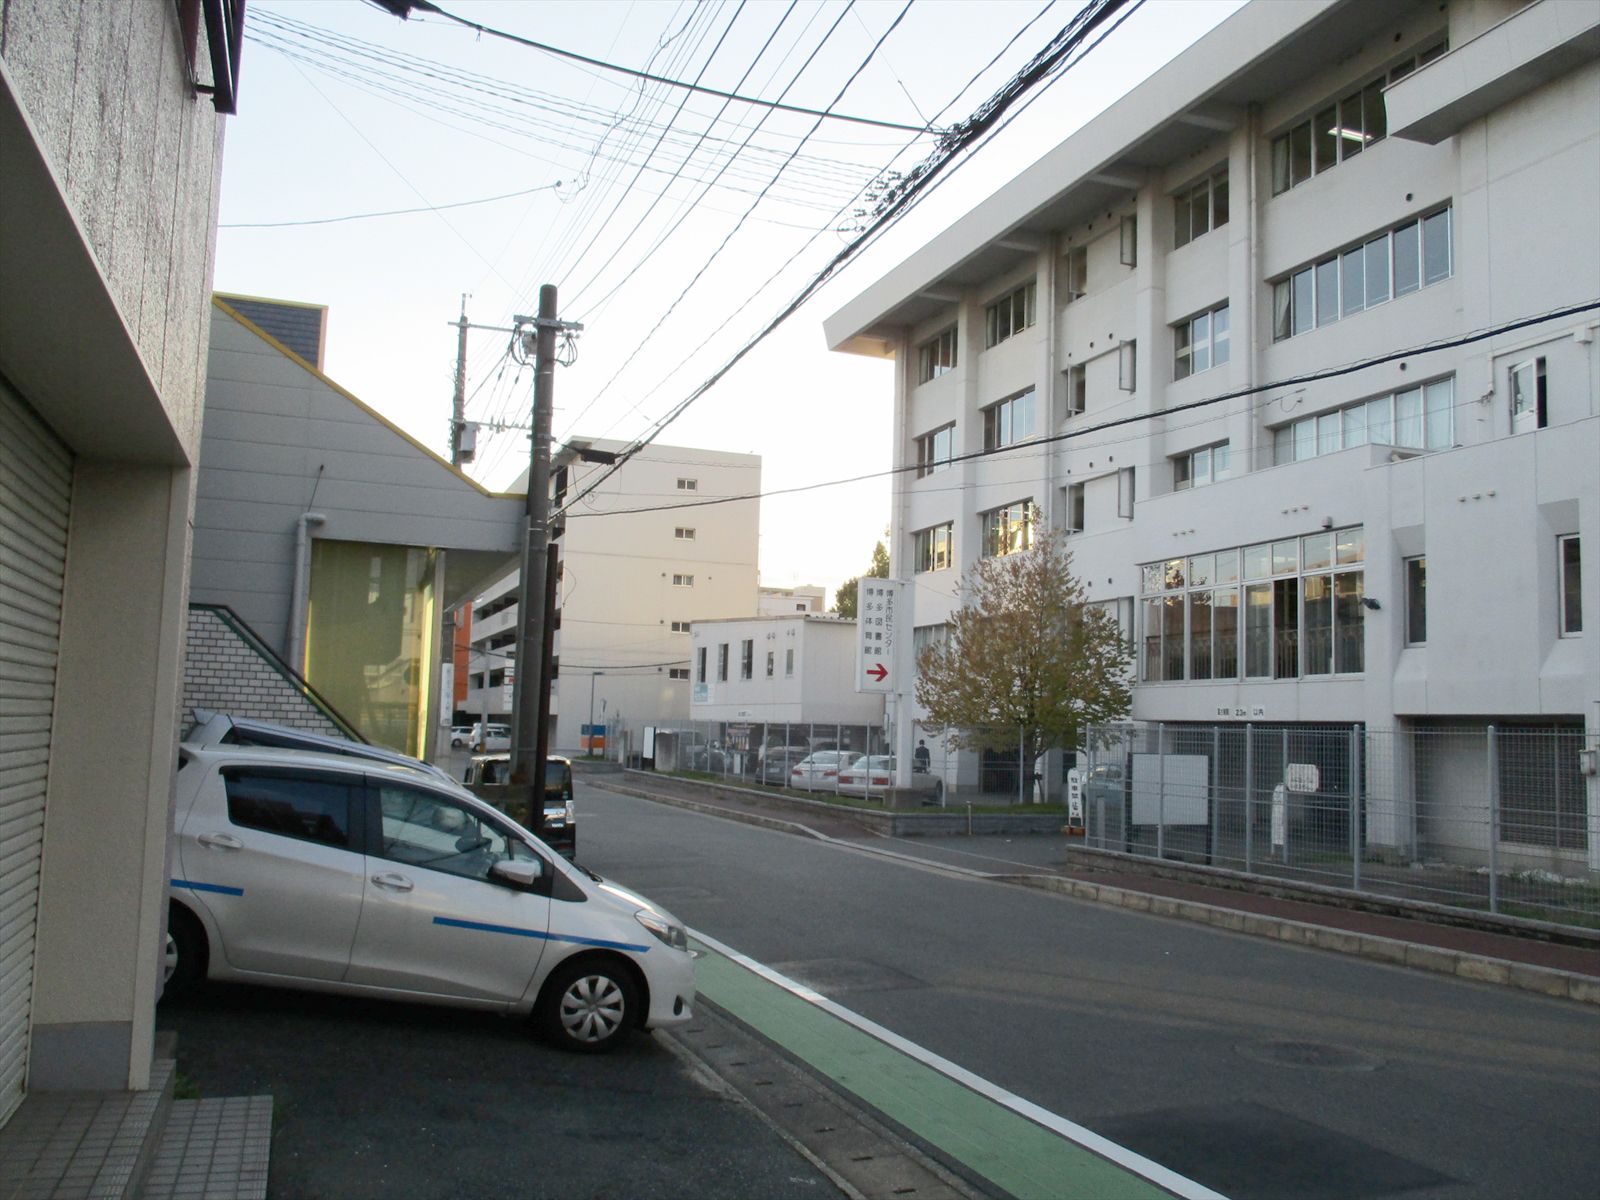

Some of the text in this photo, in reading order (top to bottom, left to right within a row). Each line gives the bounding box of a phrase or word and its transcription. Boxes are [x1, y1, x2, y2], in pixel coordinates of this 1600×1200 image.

[864, 588, 873, 654] 博多体育館
[874, 589, 883, 655] 博多図書館
[885, 590, 893, 655] 博多市民センター
